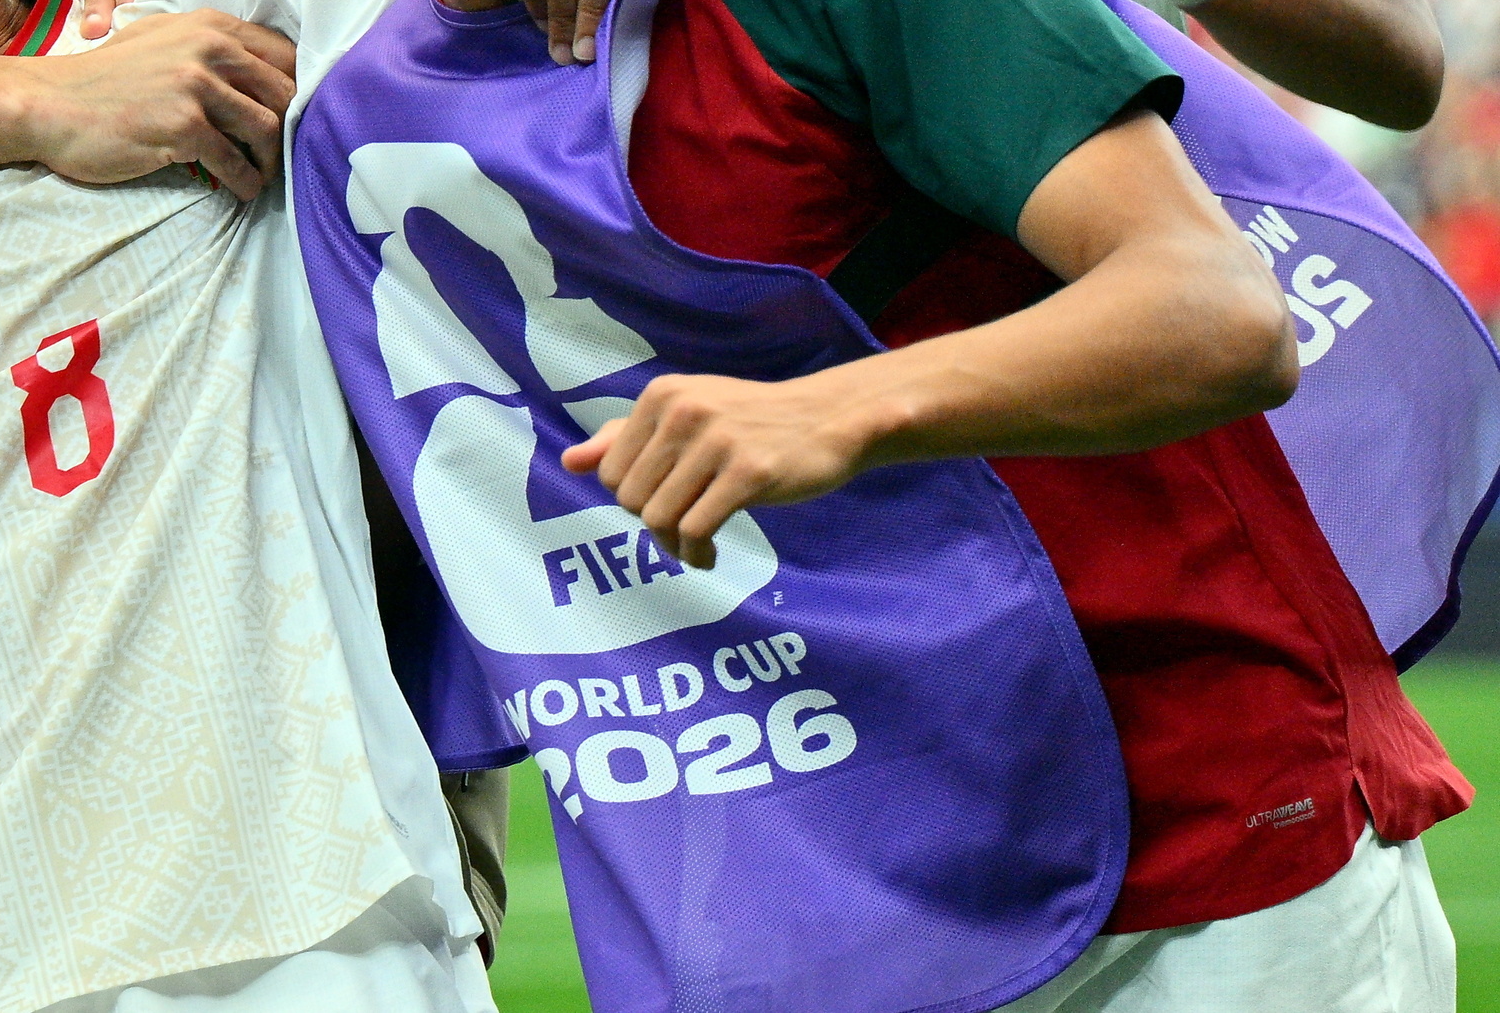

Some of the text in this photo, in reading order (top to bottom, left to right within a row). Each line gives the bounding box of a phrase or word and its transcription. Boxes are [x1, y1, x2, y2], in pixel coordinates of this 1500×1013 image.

[10, 318, 115, 498] 8
[542, 529, 685, 607] FIFA
[503, 632, 808, 740] WORLD CUP
[534, 688, 858, 825] 2026
[1245, 797, 1314, 828] ULTRAWEAVE
